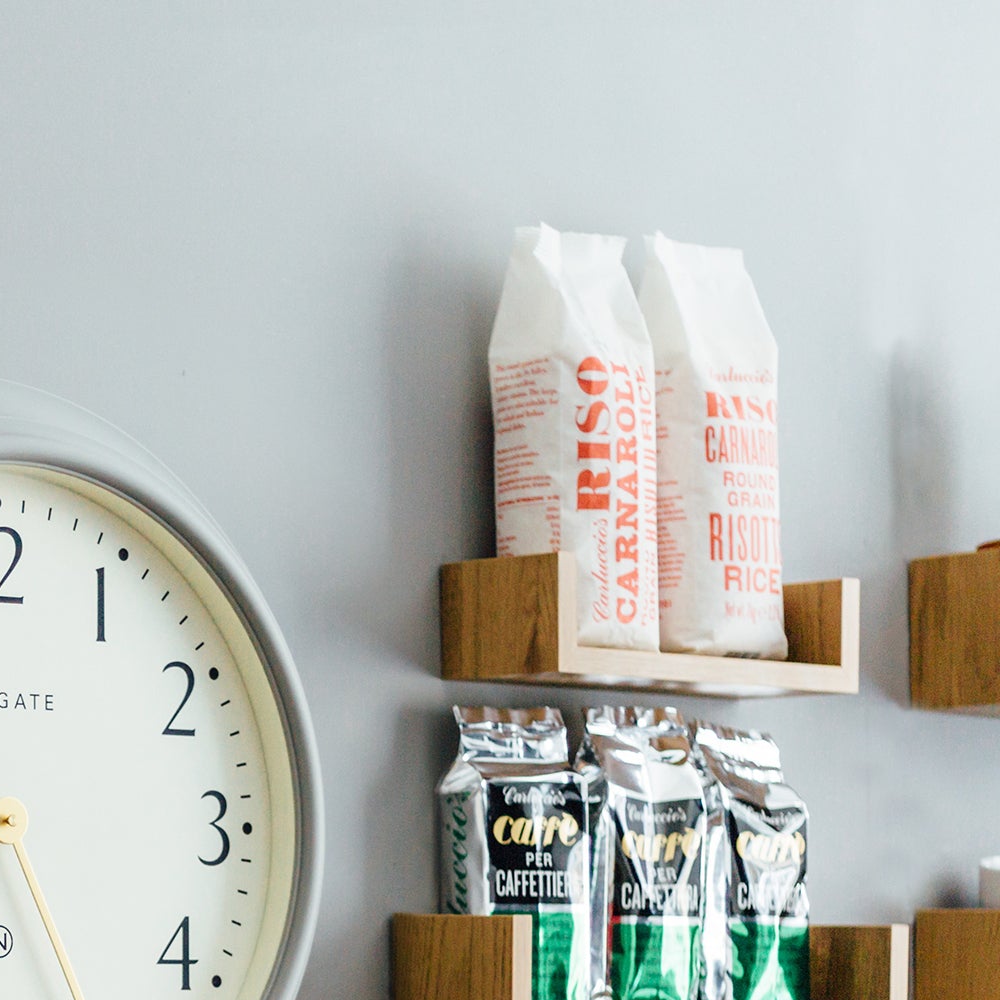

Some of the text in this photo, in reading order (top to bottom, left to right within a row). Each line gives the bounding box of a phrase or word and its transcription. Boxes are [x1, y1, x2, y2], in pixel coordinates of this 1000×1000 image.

[575, 356, 611, 512] RISO
[610, 360, 639, 625] CARNAROLI
[727, 490, 776, 509] GRAIN
[95, 567, 106, 642] 1
[724, 564, 781, 594] RICE
[161, 661, 197, 737] 2
[197, 790, 231, 867] 3
[525, 851, 553, 868] PER
[157, 916, 199, 991] 4
